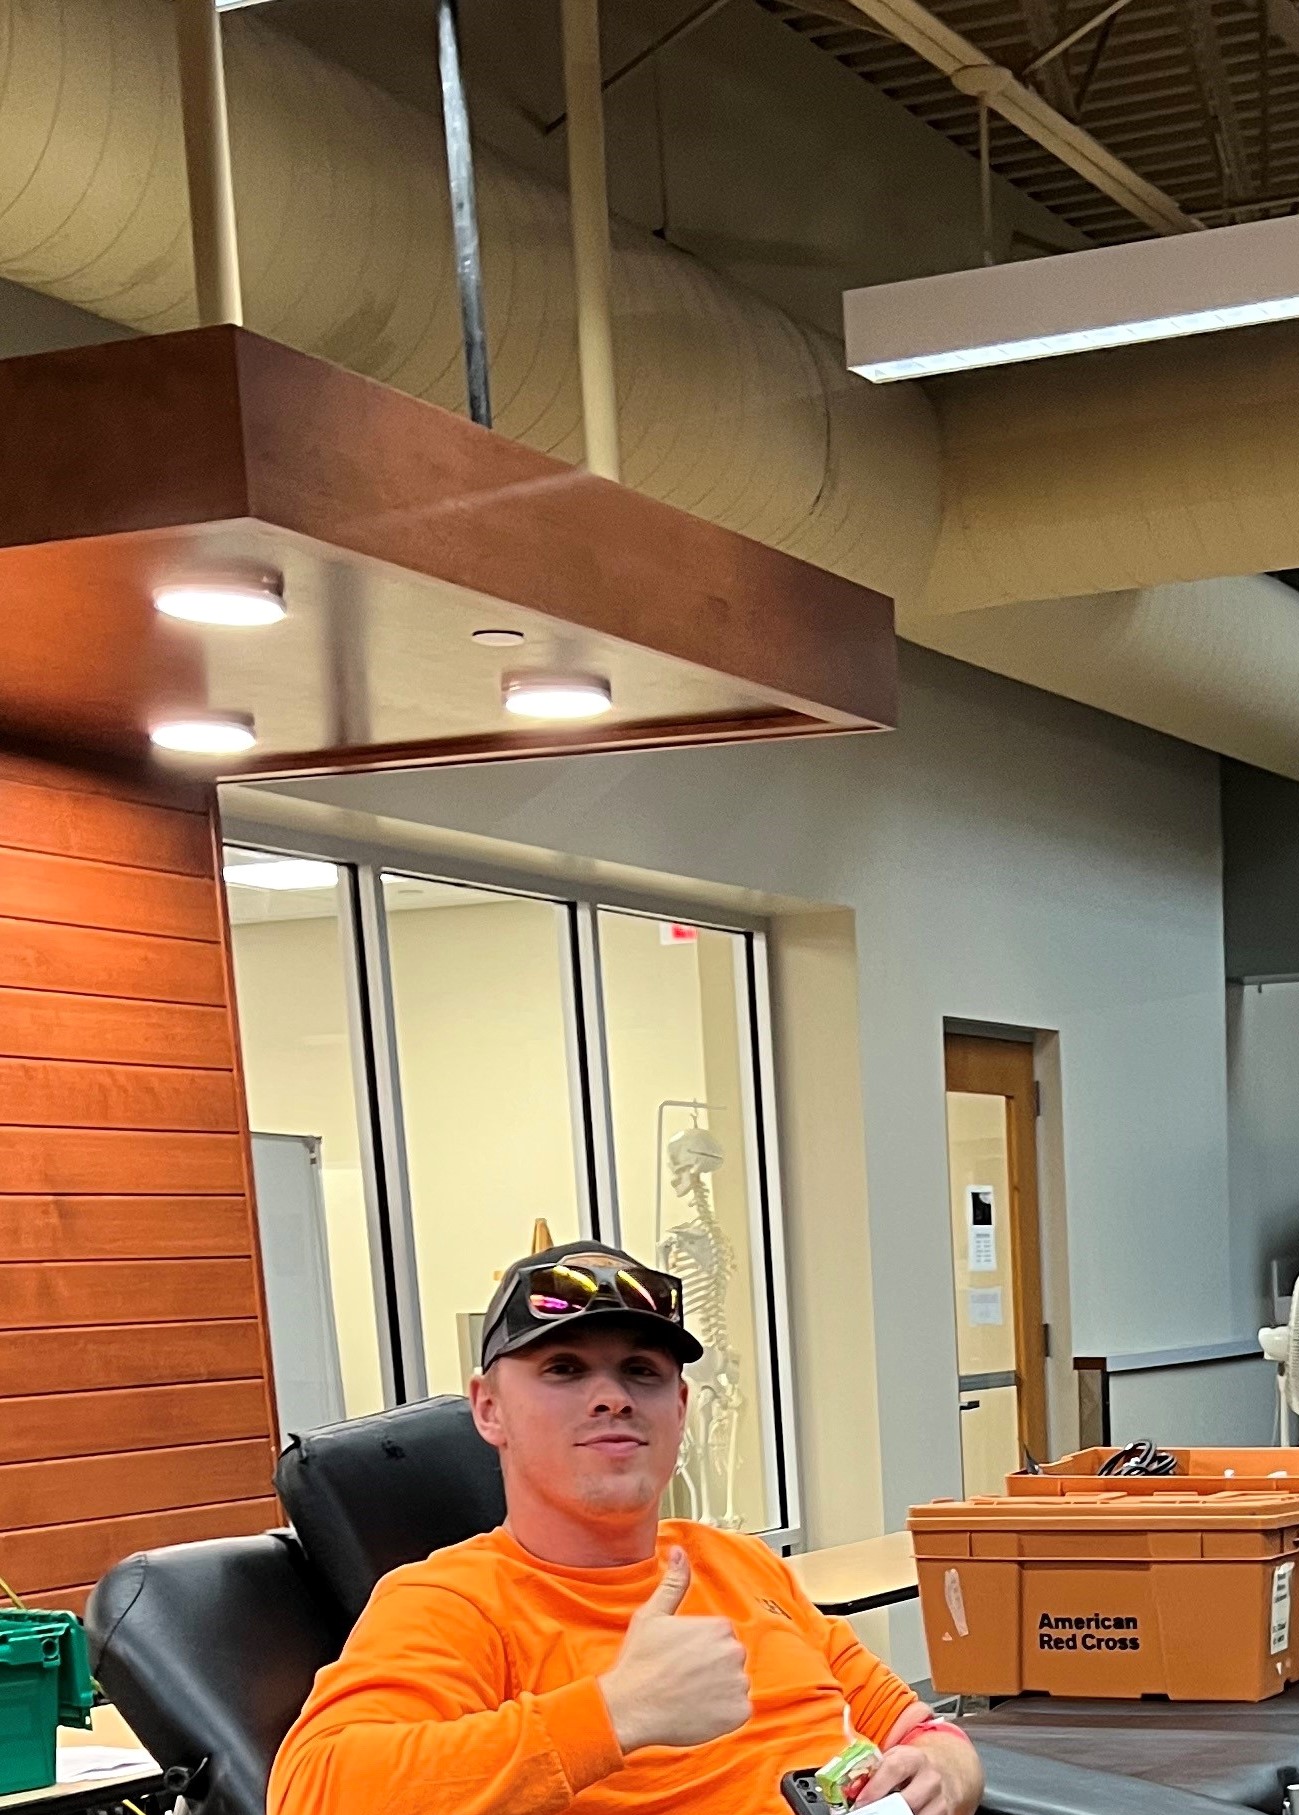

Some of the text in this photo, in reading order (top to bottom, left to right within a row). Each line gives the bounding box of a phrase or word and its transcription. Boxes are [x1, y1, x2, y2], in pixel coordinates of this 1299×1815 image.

[1039, 1612, 1138, 1630] American
[1039, 1633, 1140, 1650] Red Cross
